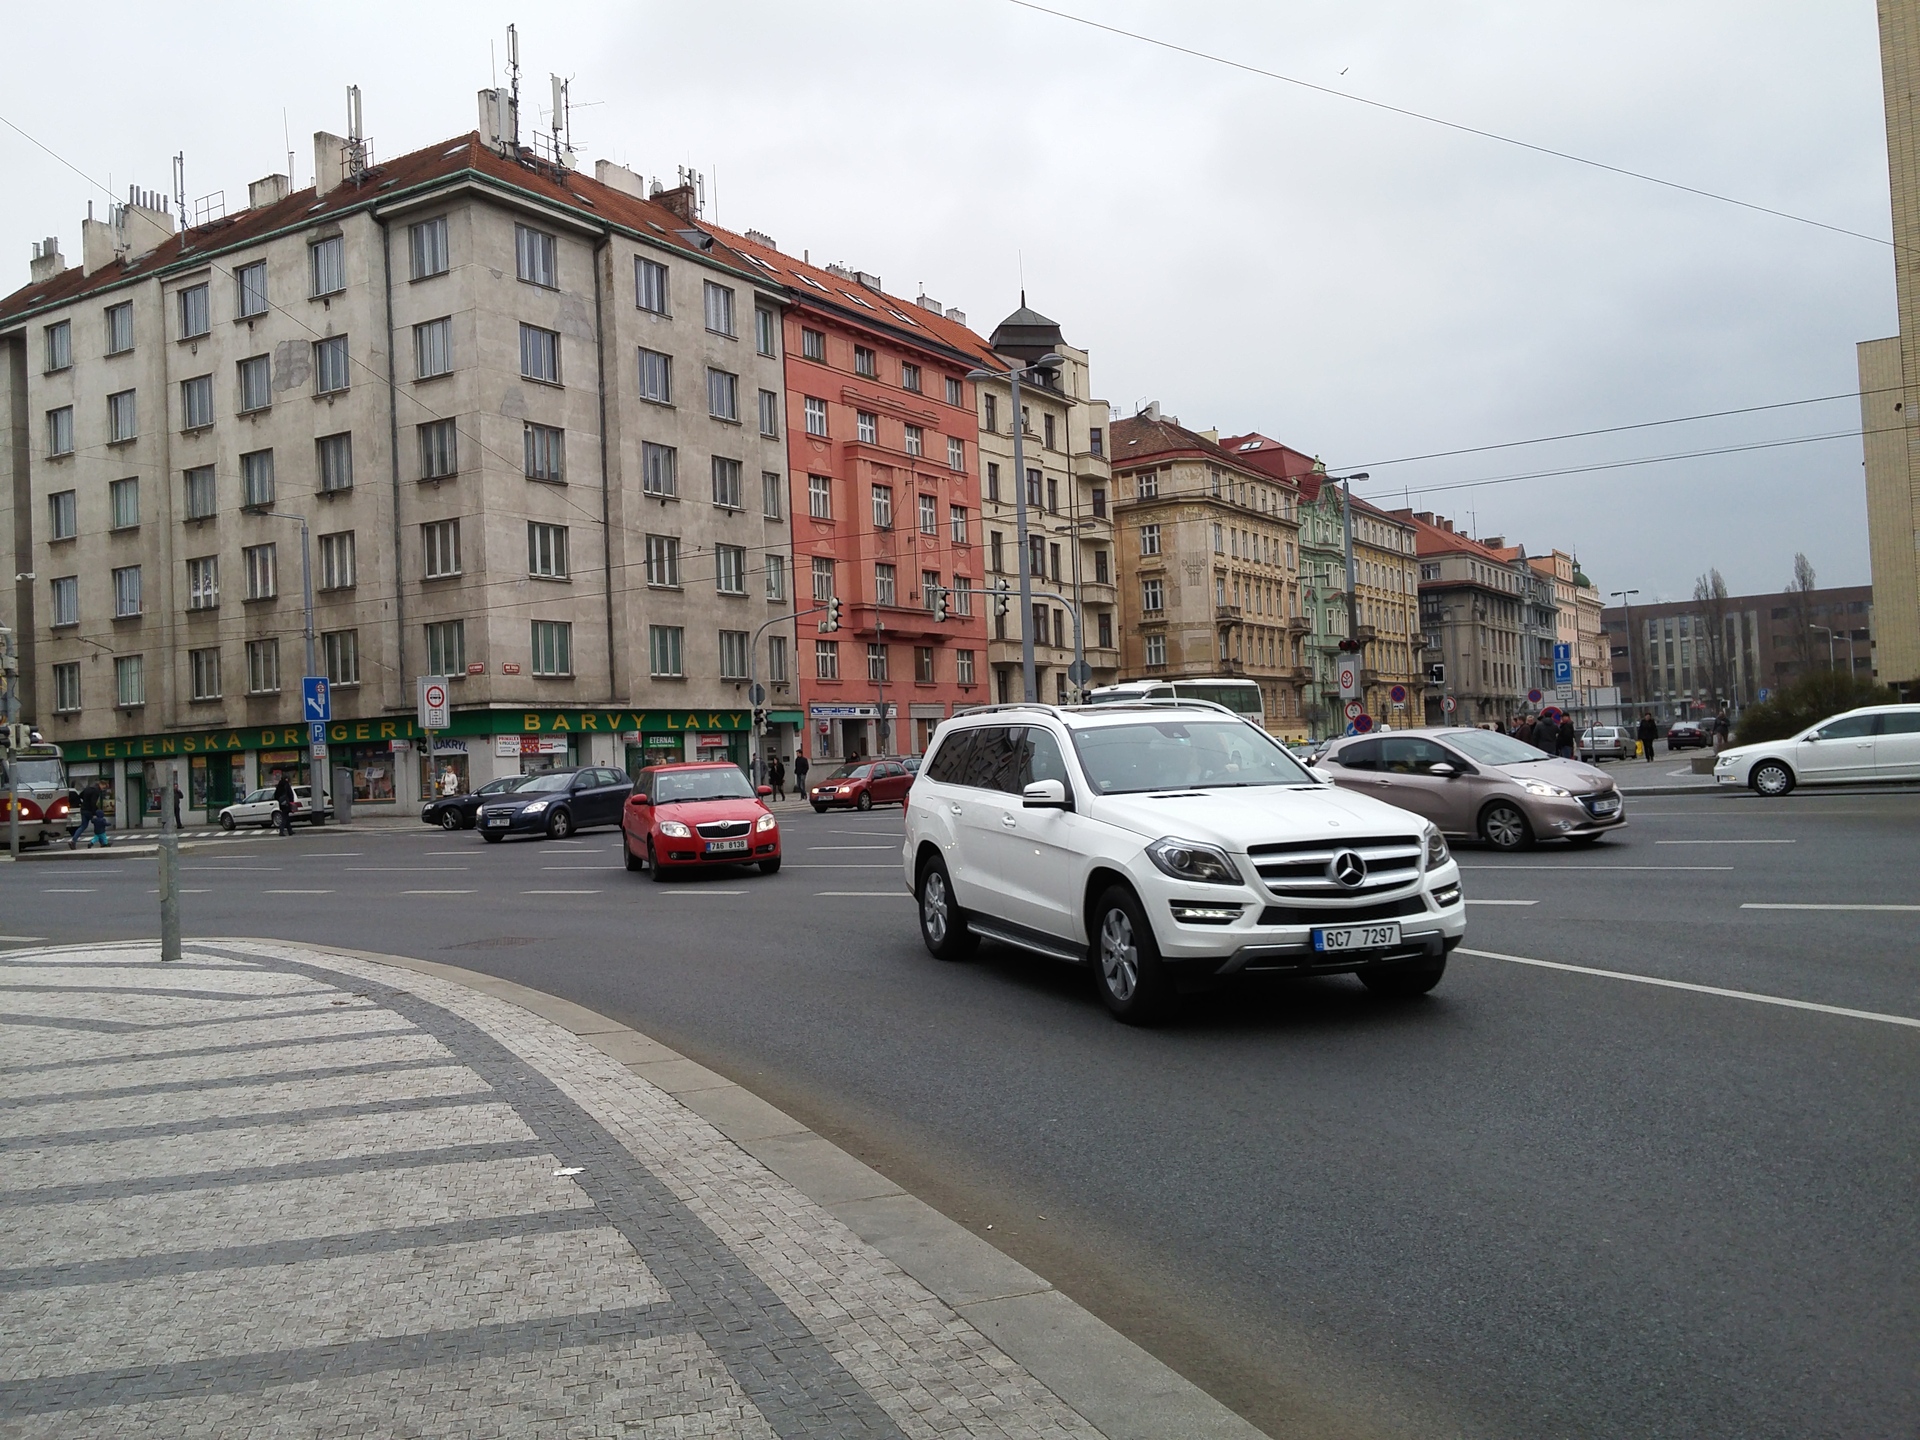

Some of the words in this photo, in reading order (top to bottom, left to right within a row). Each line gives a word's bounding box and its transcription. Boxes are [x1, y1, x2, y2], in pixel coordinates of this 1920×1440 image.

[1557, 663, 1568, 677] P
[524, 713, 646, 731] BARVY
[667, 713, 743, 729] LAKY
[314, 724, 323, 737] P
[86, 732, 242, 758] LETENSKÁ
[261, 720, 439, 746] DRGERI
[433, 738, 468, 752] LAKRYL
[649, 736, 675, 744] ETERNAL
[710, 842, 724, 851] 7A6
[728, 840, 745, 849] 8138
[1326, 930, 1352, 948] 6C7
[1362, 926, 1394, 945] 7297
